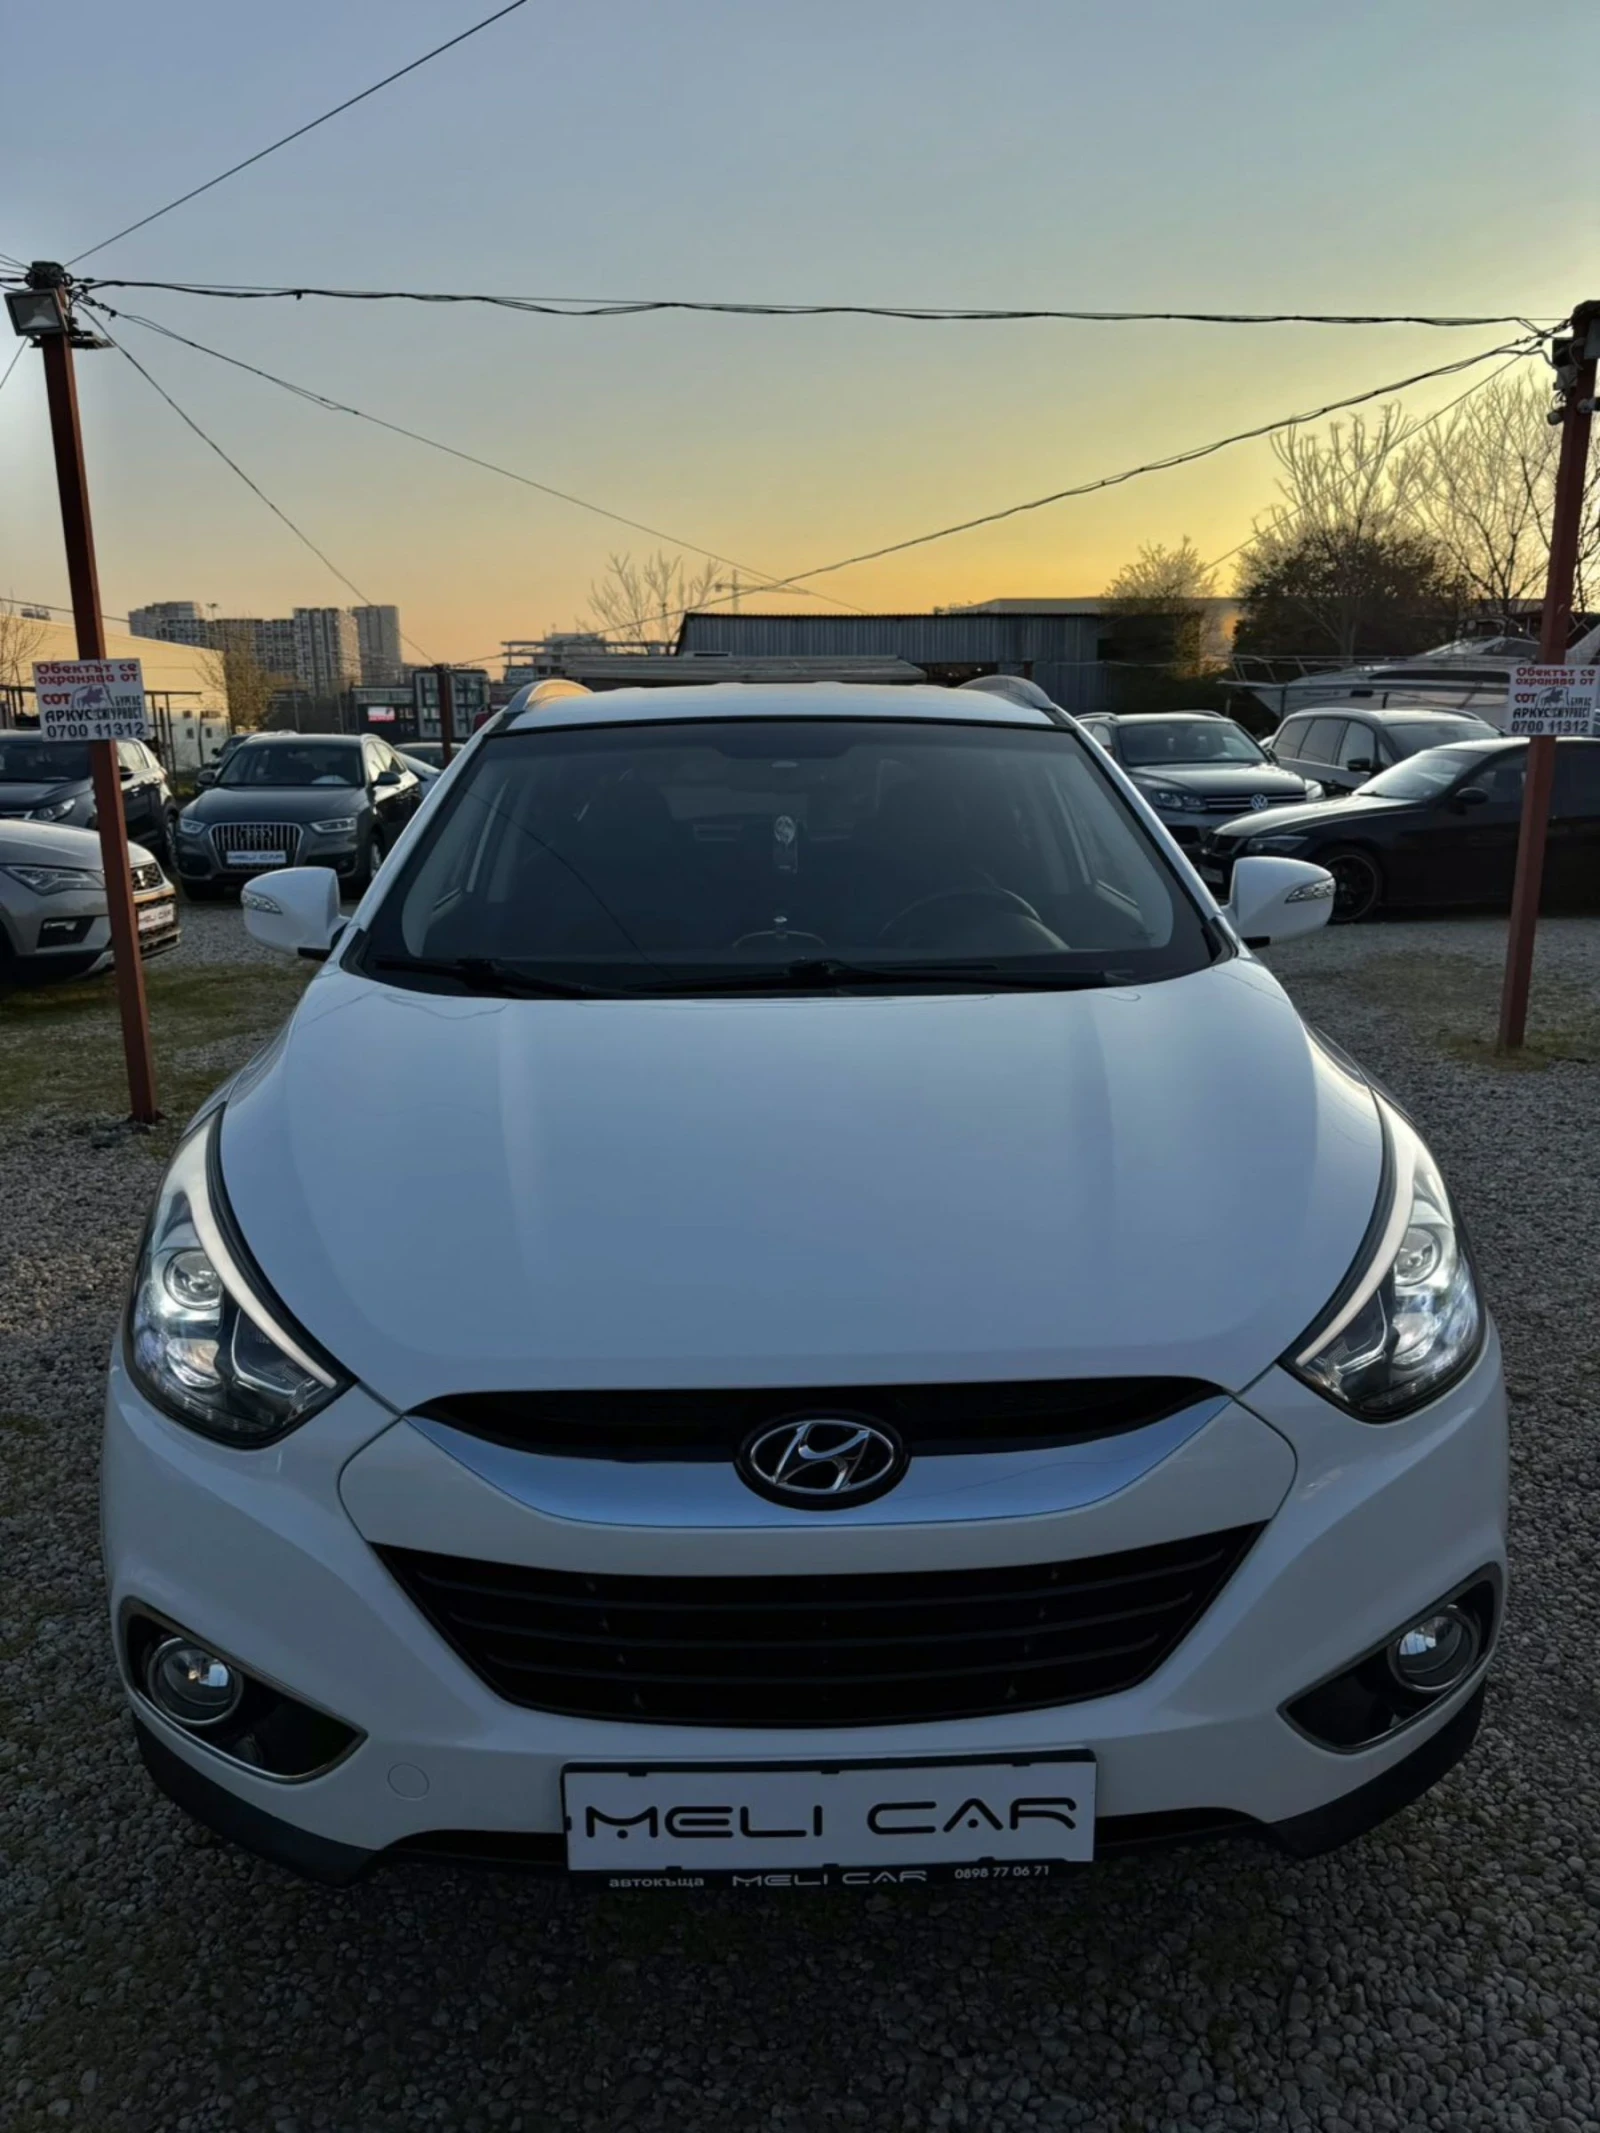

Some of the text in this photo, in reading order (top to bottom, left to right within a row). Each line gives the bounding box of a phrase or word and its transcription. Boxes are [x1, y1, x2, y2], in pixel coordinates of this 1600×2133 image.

[119, 663, 136, 672] се
[1580, 669, 1596, 677] се
[121, 673, 138, 682] от
[1580, 678, 1595, 686] от
[47, 722, 144, 737] 0700 11312
[1511, 720, 1588, 732] 0700 11312
[586, 1798, 1077, 1840] MELI CAR
[954, 1865, 1049, 1880] 0898 77 06 71
[608, 1877, 704, 1888] автокъща
[732, 1870, 928, 1887] MELI CAR
